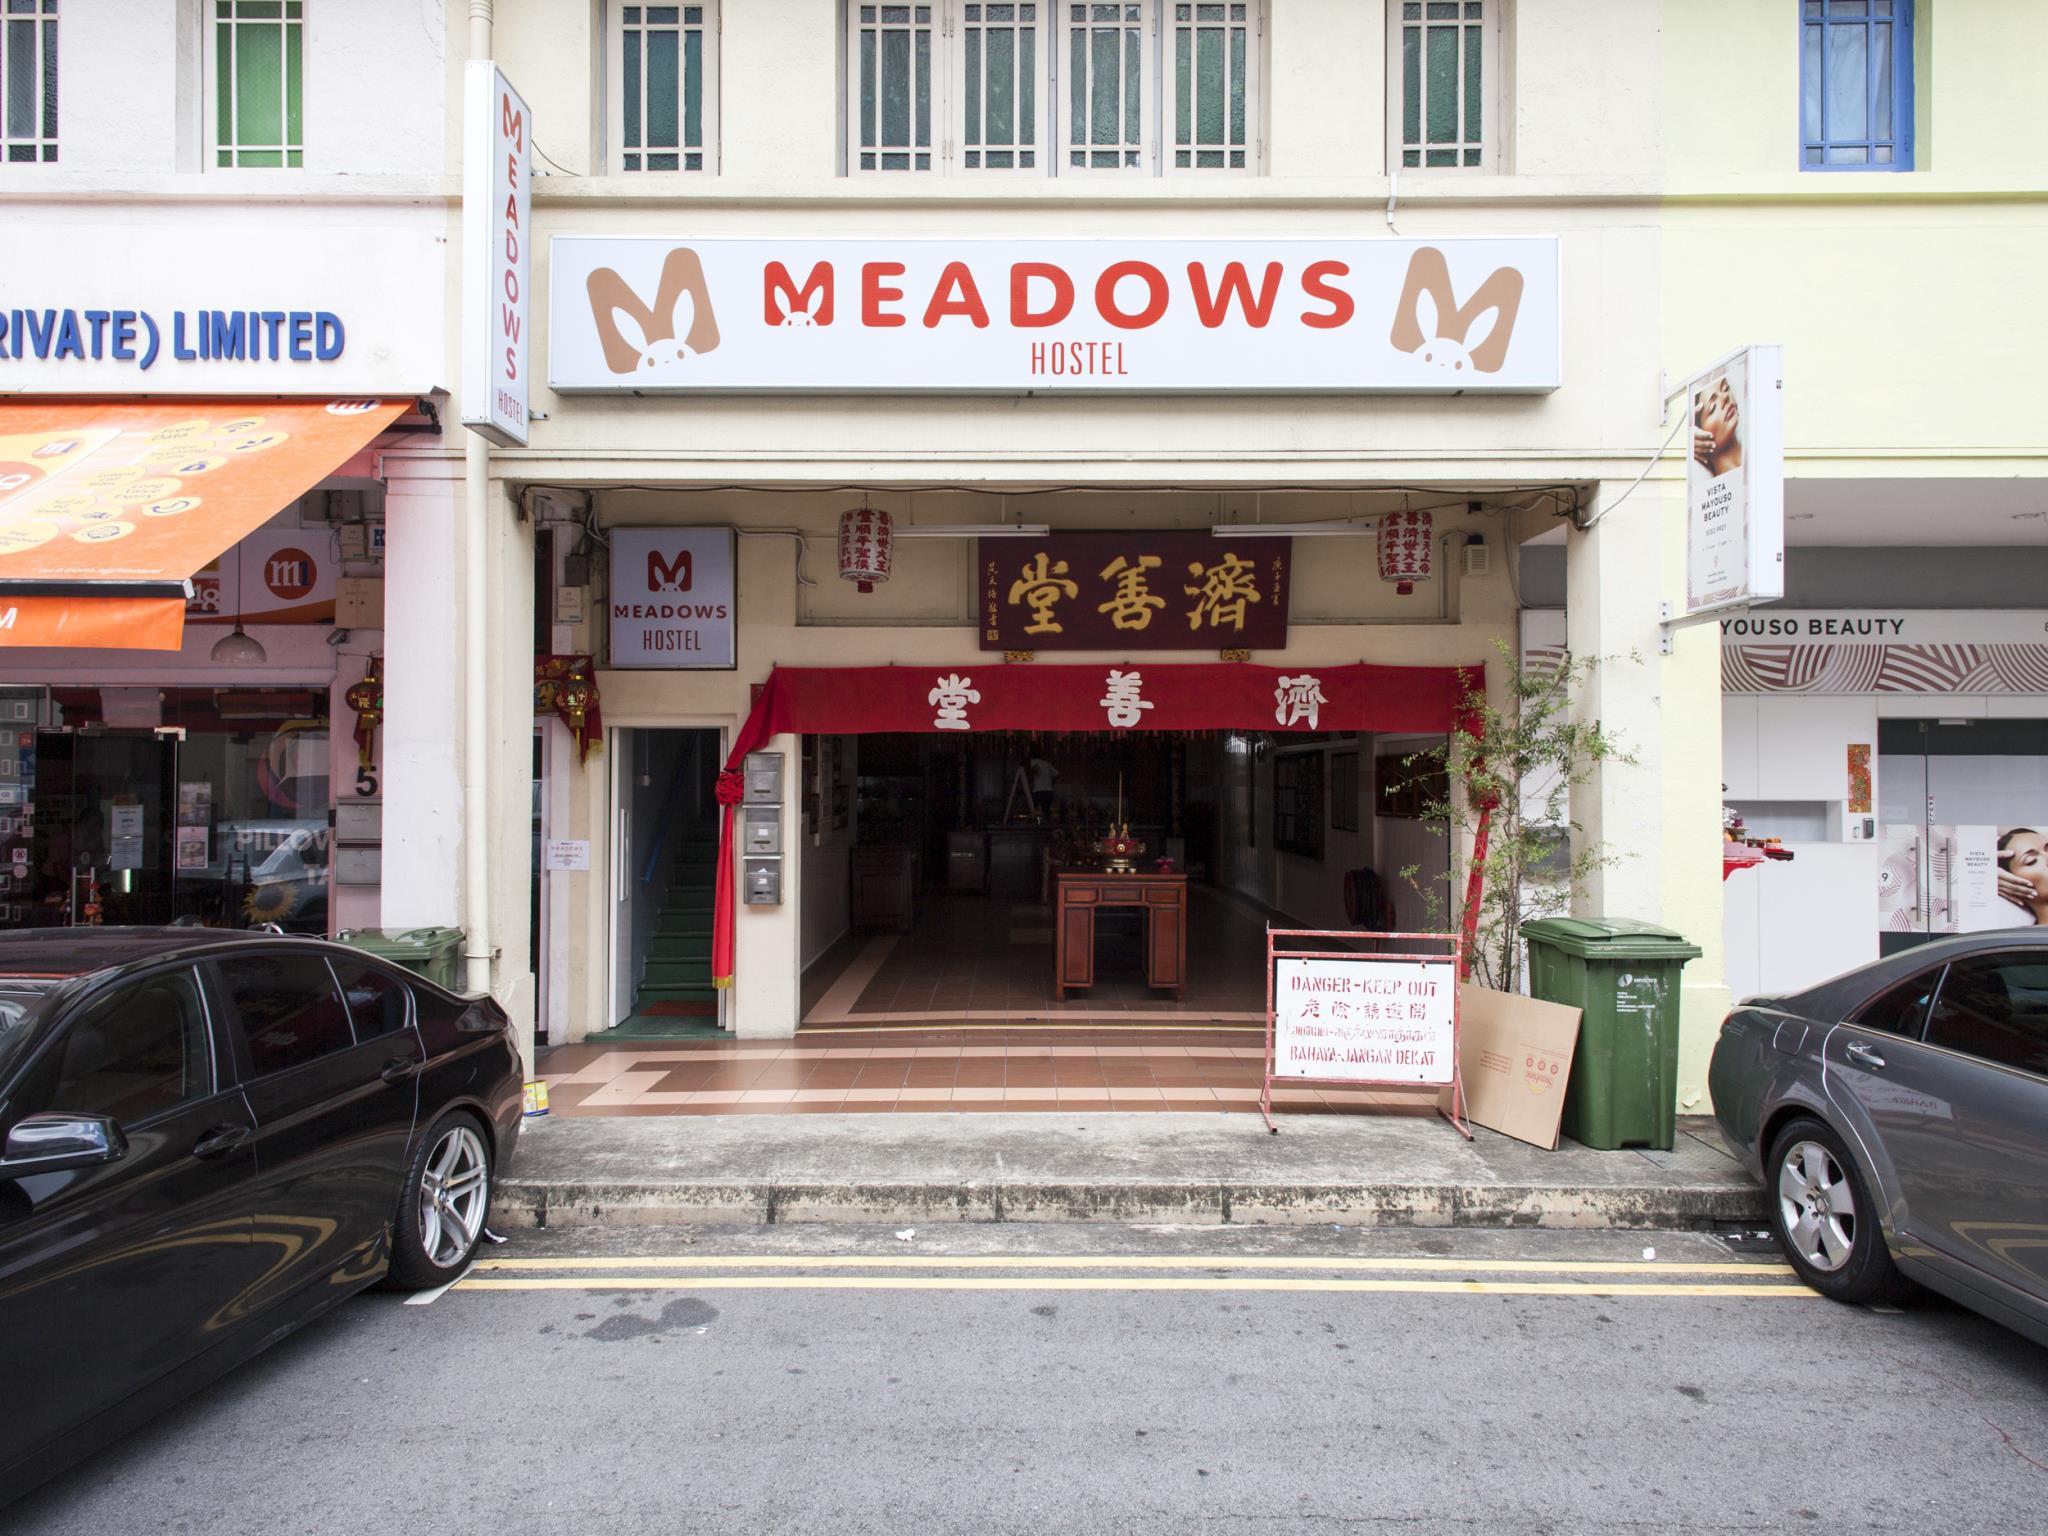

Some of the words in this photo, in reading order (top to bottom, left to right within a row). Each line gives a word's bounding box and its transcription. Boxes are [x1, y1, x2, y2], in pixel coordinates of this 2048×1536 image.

[503, 92, 523, 381] MEADOWS
[764, 260, 1355, 329] MEADOWS
[173, 311, 345, 361] LIMITED
[1032, 342, 1128, 375] HOSTEL
[498, 388, 524, 426] HOSTEL
[1706, 482, 1727, 497] VISTA
[1701, 492, 1732, 511] MAYOUSO
[1703, 505, 1730, 522] BEAUTY
[269, 560, 312, 587] m1
[614, 604, 728, 619] MEADOWS
[1808, 619, 1904, 636] BEAUTY
[643, 629, 701, 651] HOSTEL
[356, 765, 377, 797] 5
[1408, 981, 1438, 997] OUT
[1396, 1050, 1438, 1066] DEKAT
